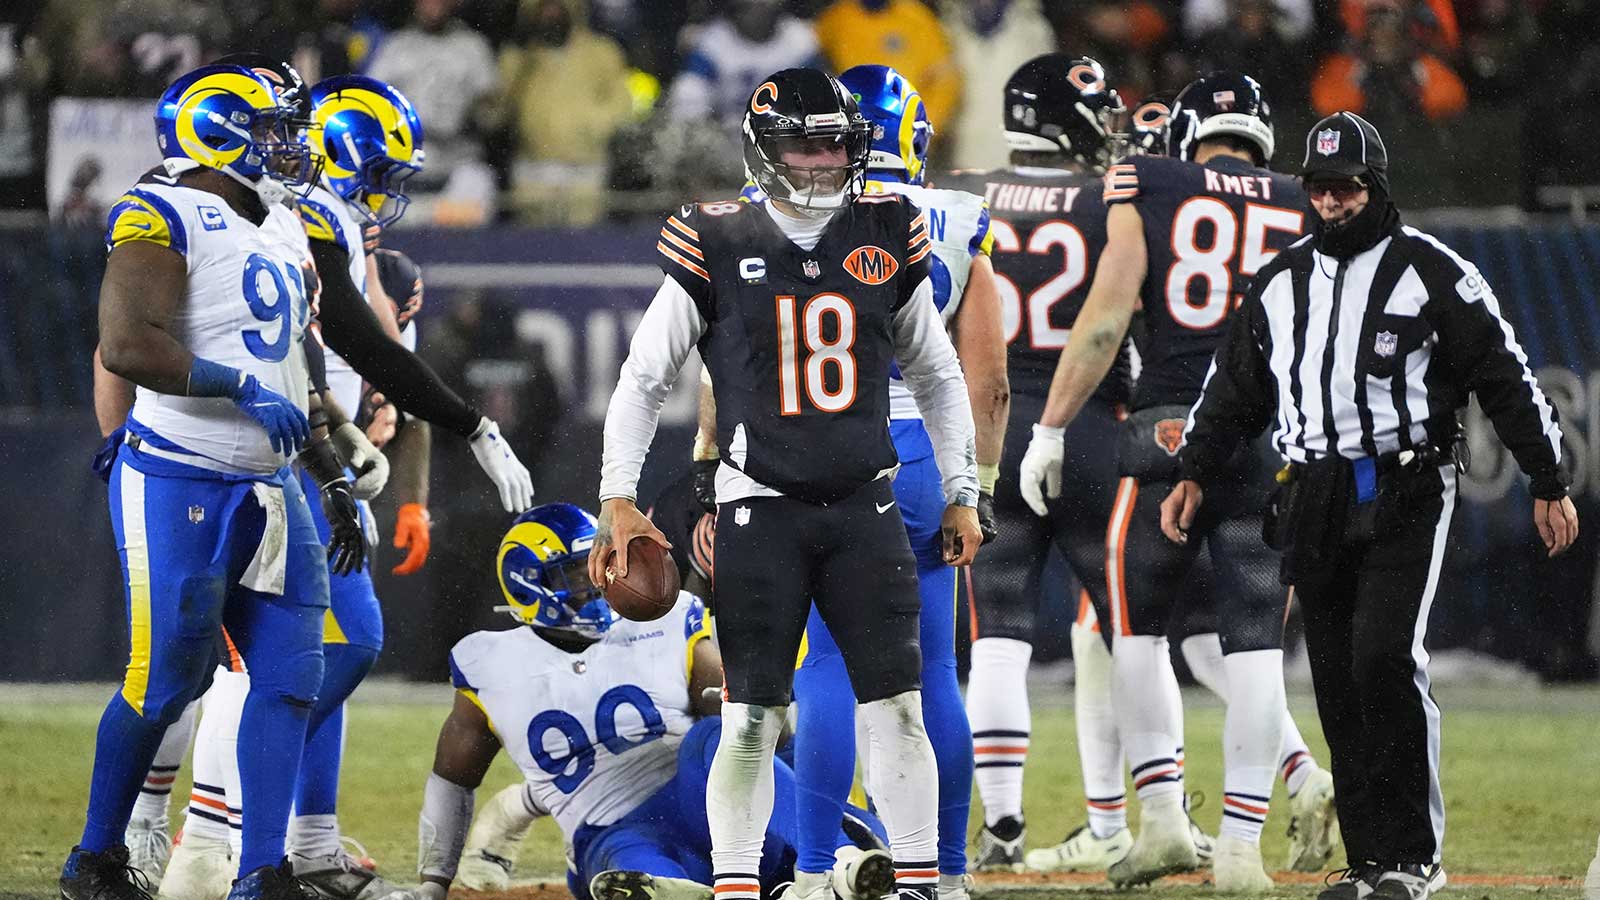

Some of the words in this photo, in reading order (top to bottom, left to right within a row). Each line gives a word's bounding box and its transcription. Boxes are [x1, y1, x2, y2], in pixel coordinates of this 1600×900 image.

[751, 81, 778, 114] C
[985, 182, 1080, 213] THUNEY
[1204, 168, 1272, 200] KMET
[201, 207, 223, 225] C
[738, 257, 767, 280] C
[850, 251, 893, 281] VMH
[1165, 195, 1304, 330] 85
[775, 292, 858, 416] 18
[527, 684, 667, 794] 90
